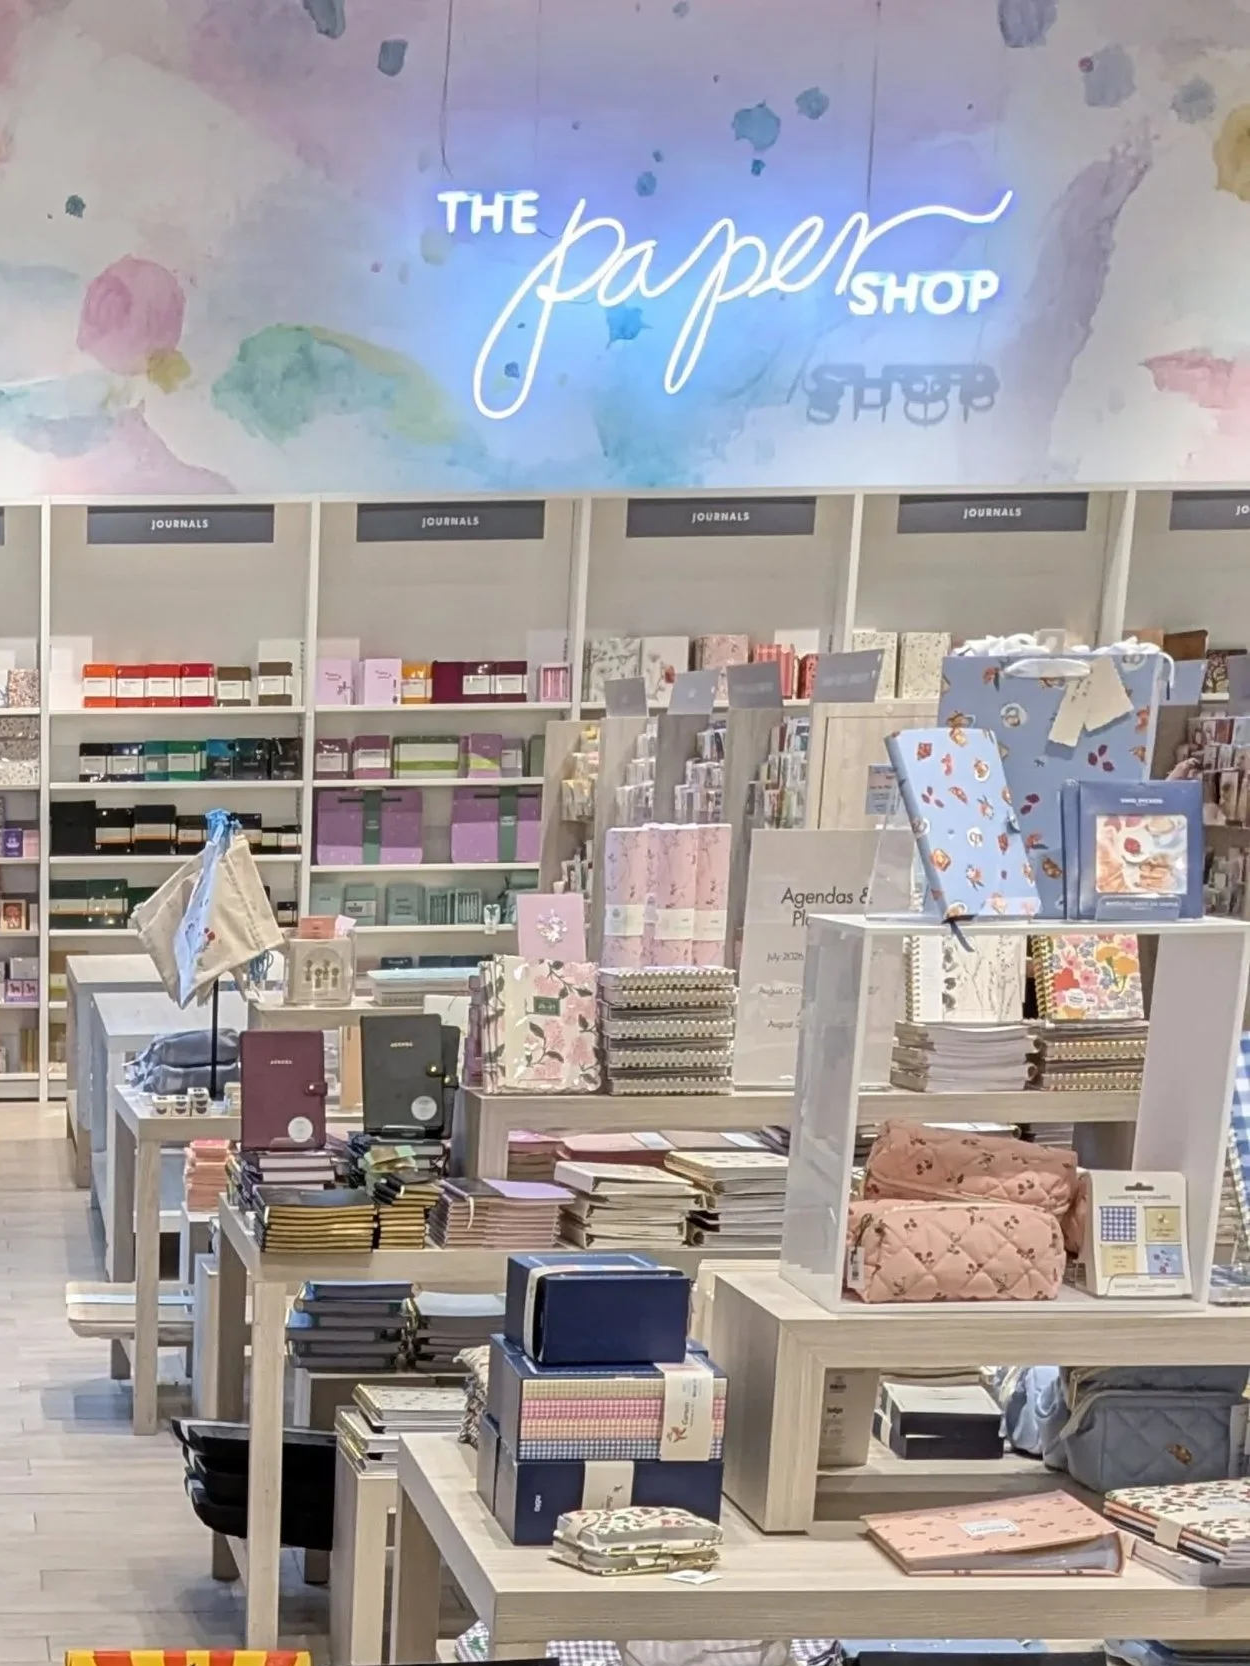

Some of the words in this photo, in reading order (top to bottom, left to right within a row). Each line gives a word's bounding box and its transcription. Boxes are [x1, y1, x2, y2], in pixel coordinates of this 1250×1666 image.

[437, 190, 539, 234] THE
[848, 270, 999, 315] SHOP
[473, 190, 1014, 419] paper
[421, 516, 480, 528] JOURNALS
[692, 511, 750, 524] JOURNALS
[963, 508, 1022, 520] JOURNALS
[151, 519, 209, 531] JOURNALS
[781, 886, 854, 908] Agendas
